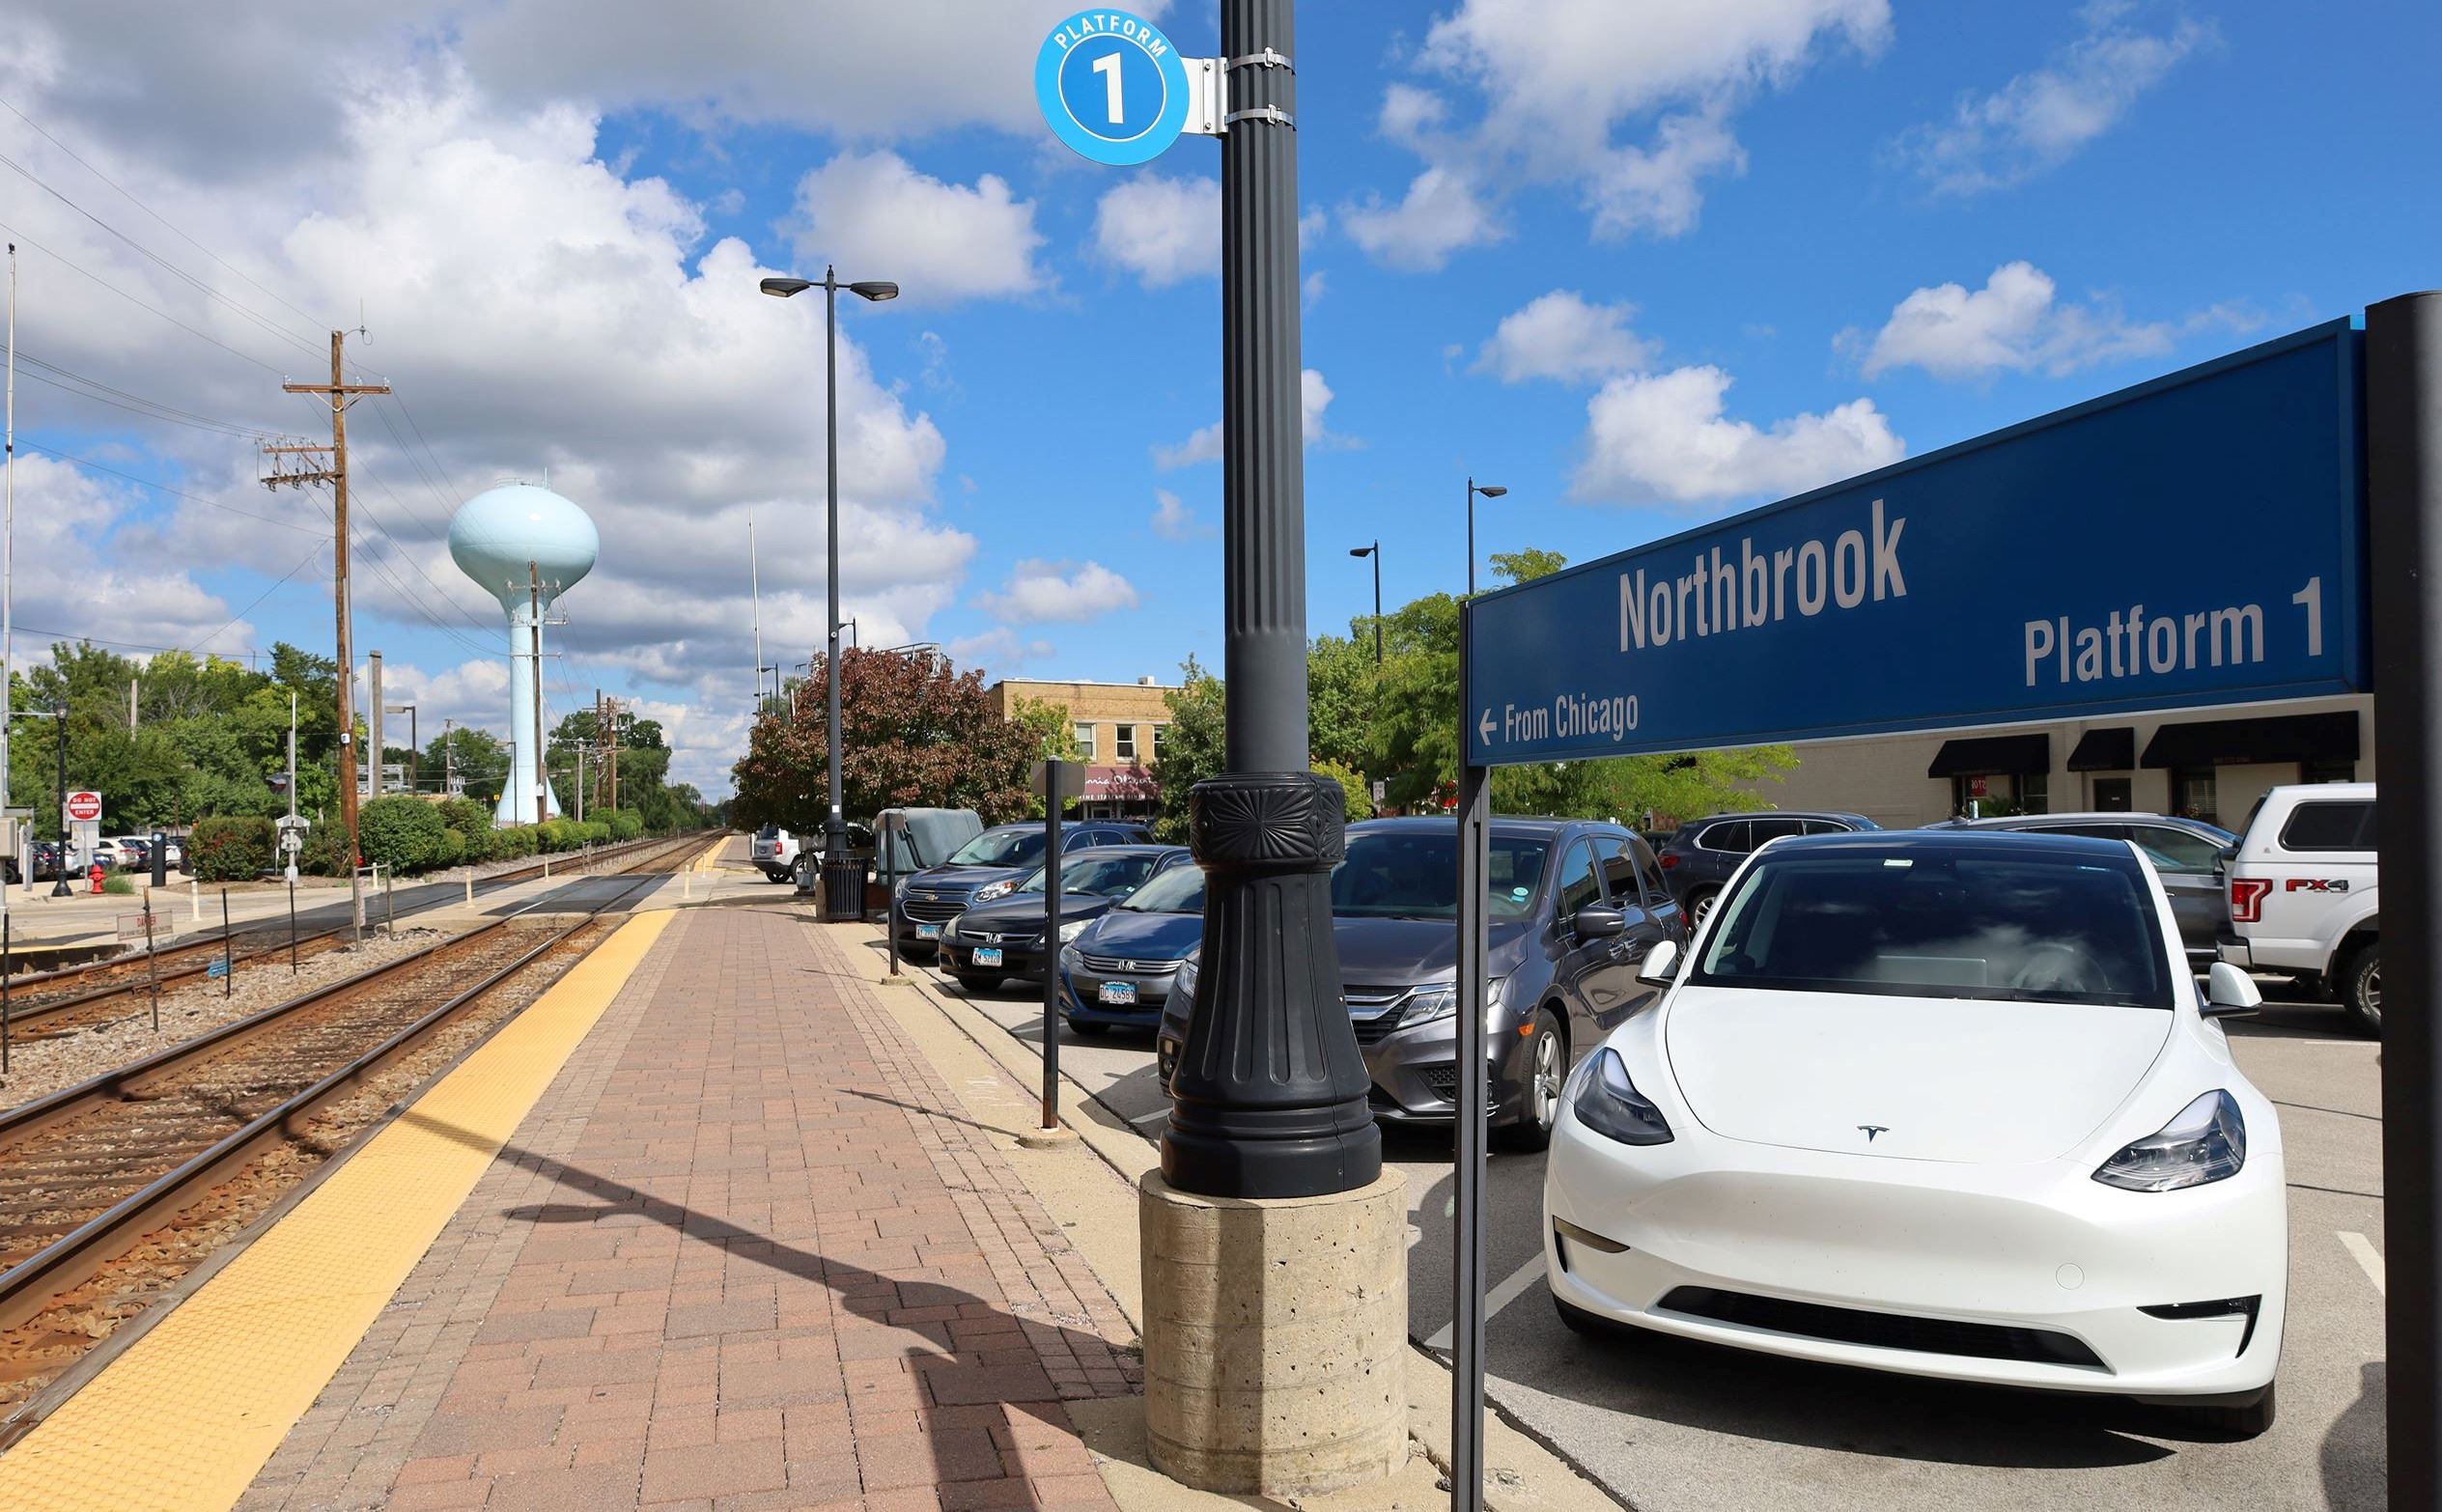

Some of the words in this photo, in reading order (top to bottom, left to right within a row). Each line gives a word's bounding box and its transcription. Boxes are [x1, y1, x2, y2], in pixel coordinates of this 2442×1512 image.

[1053, 14, 1167, 58] PLATFORM
[1092, 52, 1124, 125] 1
[1619, 498, 1907, 653] Northbrook
[2025, 603, 2264, 686] Platform
[2292, 576, 2321, 657] 1
[1504, 704, 1548, 742] From
[1556, 692, 1639, 742] Chicago
[2286, 878, 2349, 893] FX4
